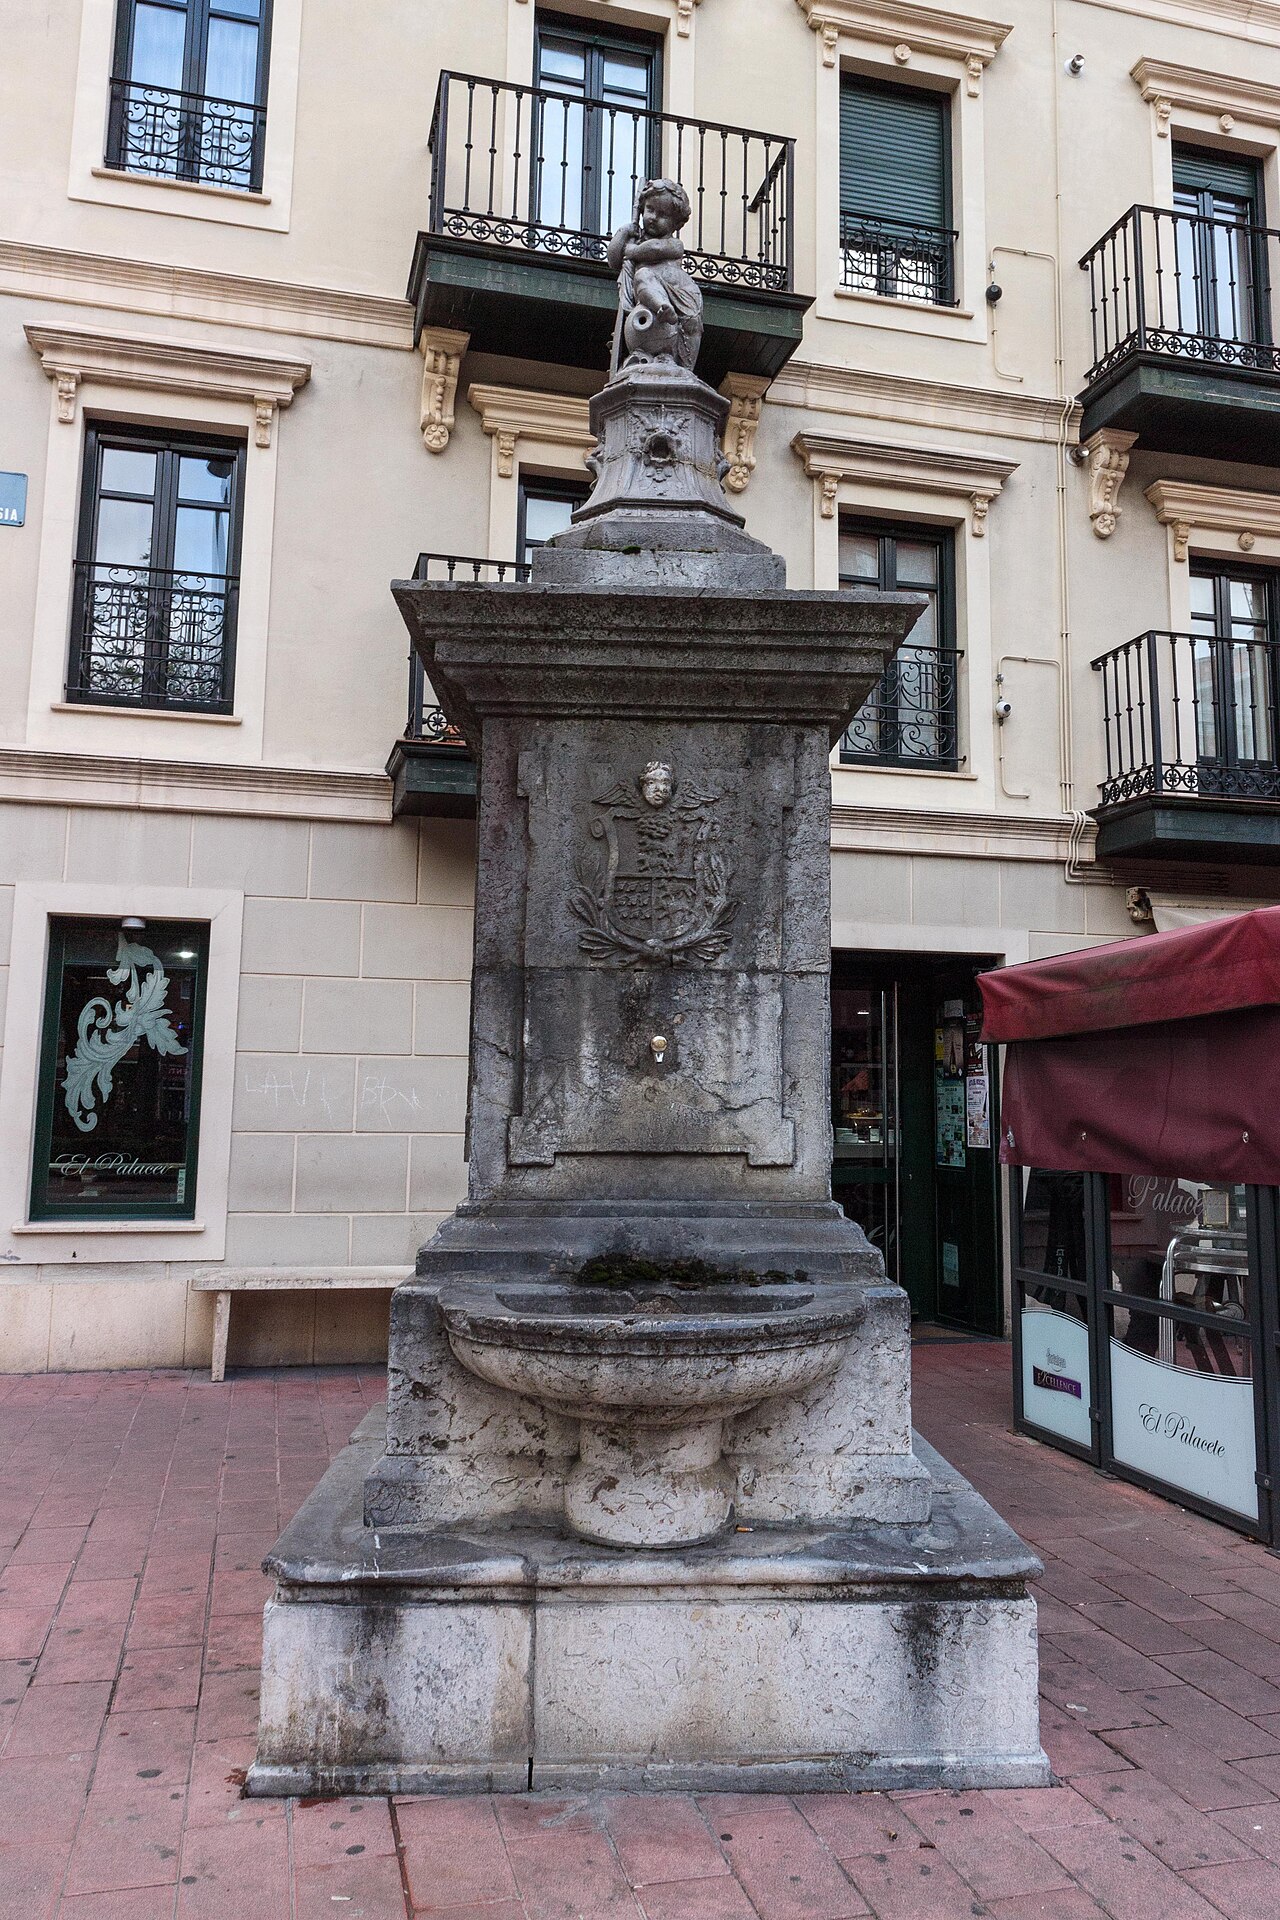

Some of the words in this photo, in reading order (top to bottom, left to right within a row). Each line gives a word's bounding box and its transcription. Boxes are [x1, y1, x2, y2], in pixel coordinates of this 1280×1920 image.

[55, 1153, 91, 1176] El
[1127, 1174, 1205, 1215] Palace
[1138, 1403, 1162, 1434] El
[1164, 1412, 1226, 1458] Palacete
